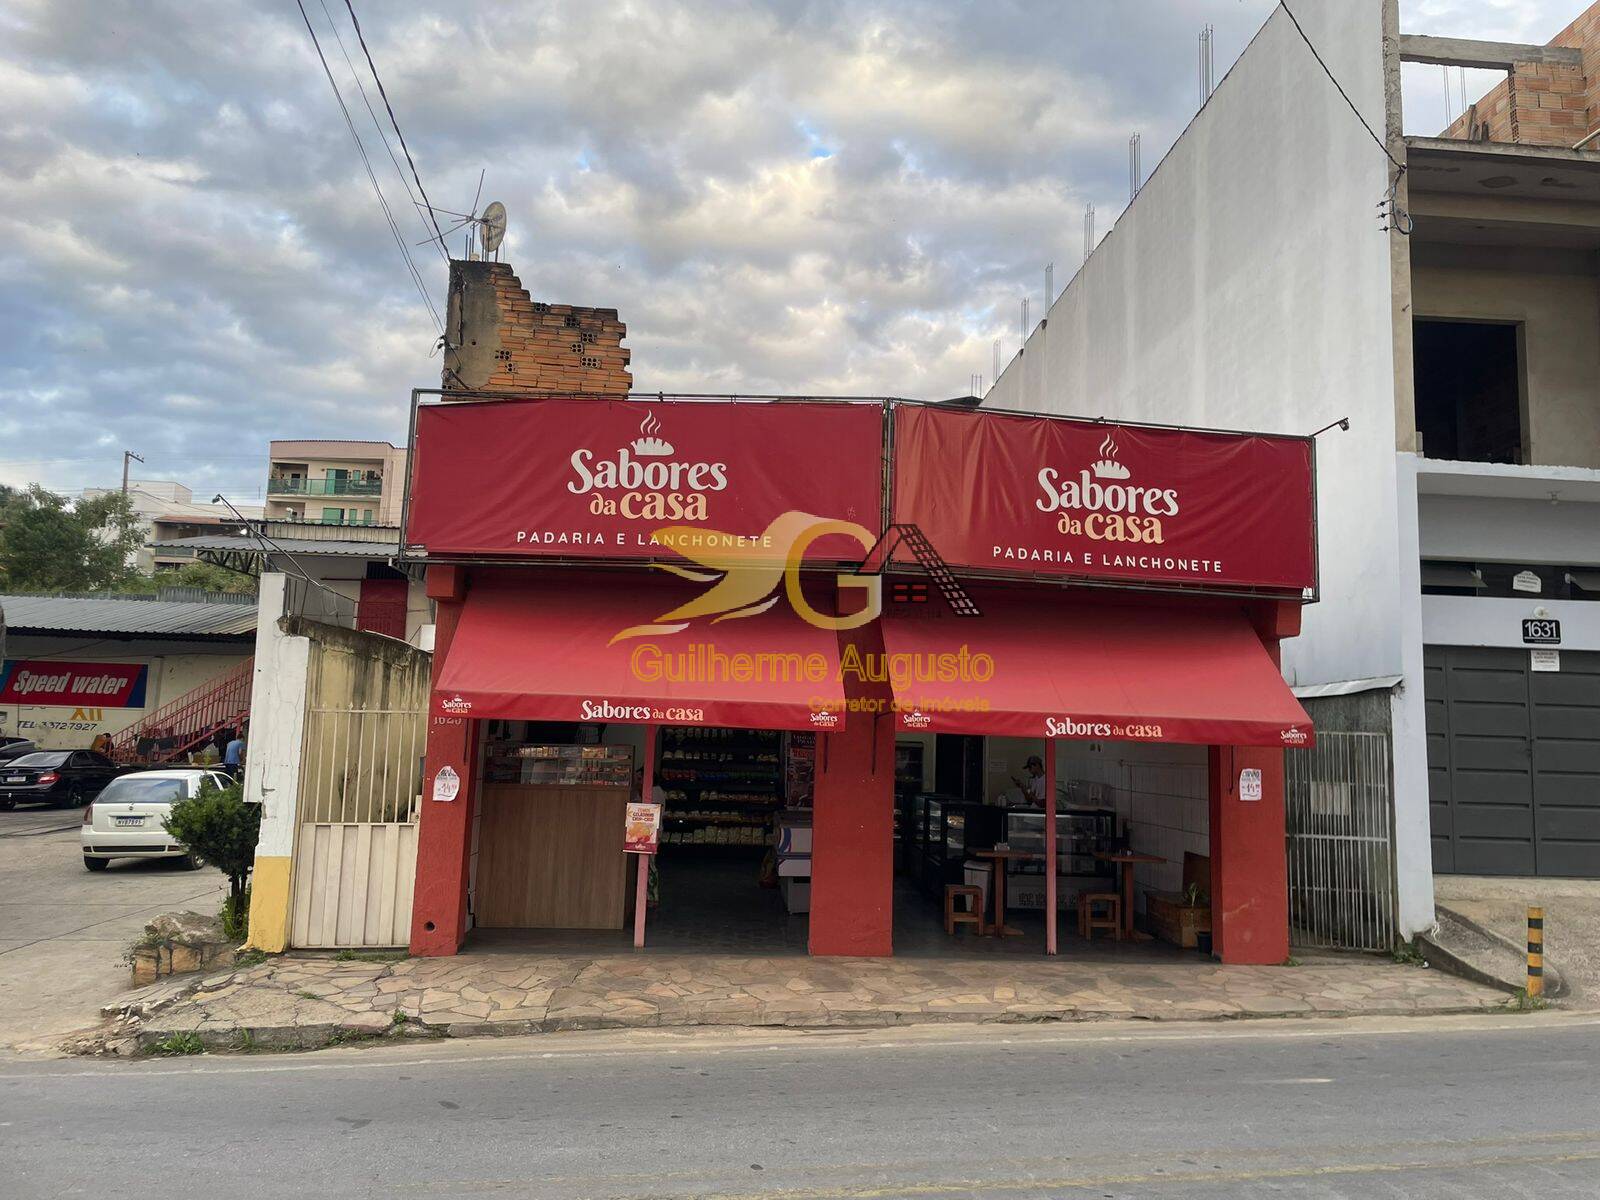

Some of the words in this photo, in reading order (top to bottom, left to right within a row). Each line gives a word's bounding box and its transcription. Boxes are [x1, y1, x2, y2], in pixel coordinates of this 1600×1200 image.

[566, 449, 728, 494] Sabores
[1036, 467, 1179, 516] Sabores
[590, 493, 617, 516] da
[619, 491, 709, 521] casa
[1058, 512, 1082, 535] da
[1084, 513, 1165, 544] casa
[517, 531, 605, 545] PADARIA
[616, 533, 626, 545] E
[637, 532, 773, 548] LANCHONETE
[993, 546, 1074, 564] PADARIA
[1084, 553, 1092, 565] E
[1103, 554, 1222, 573] LANCHONETE
[1524, 621, 1557, 638] 1631
[13, 670, 71, 695] Speed
[71, 675, 128, 695] water
[442, 700, 472, 708] Sabores
[580, 700, 651, 720] Sabores
[652, 708, 664, 719] da
[666, 708, 704, 720] casa
[810, 713, 838, 722] Sabores
[903, 714, 931, 723] Sabores
[1045, 717, 1111, 736] Sabores
[1113, 725, 1124, 735] da
[1126, 725, 1162, 737] casa
[1280, 730, 1307, 740] Sabores
